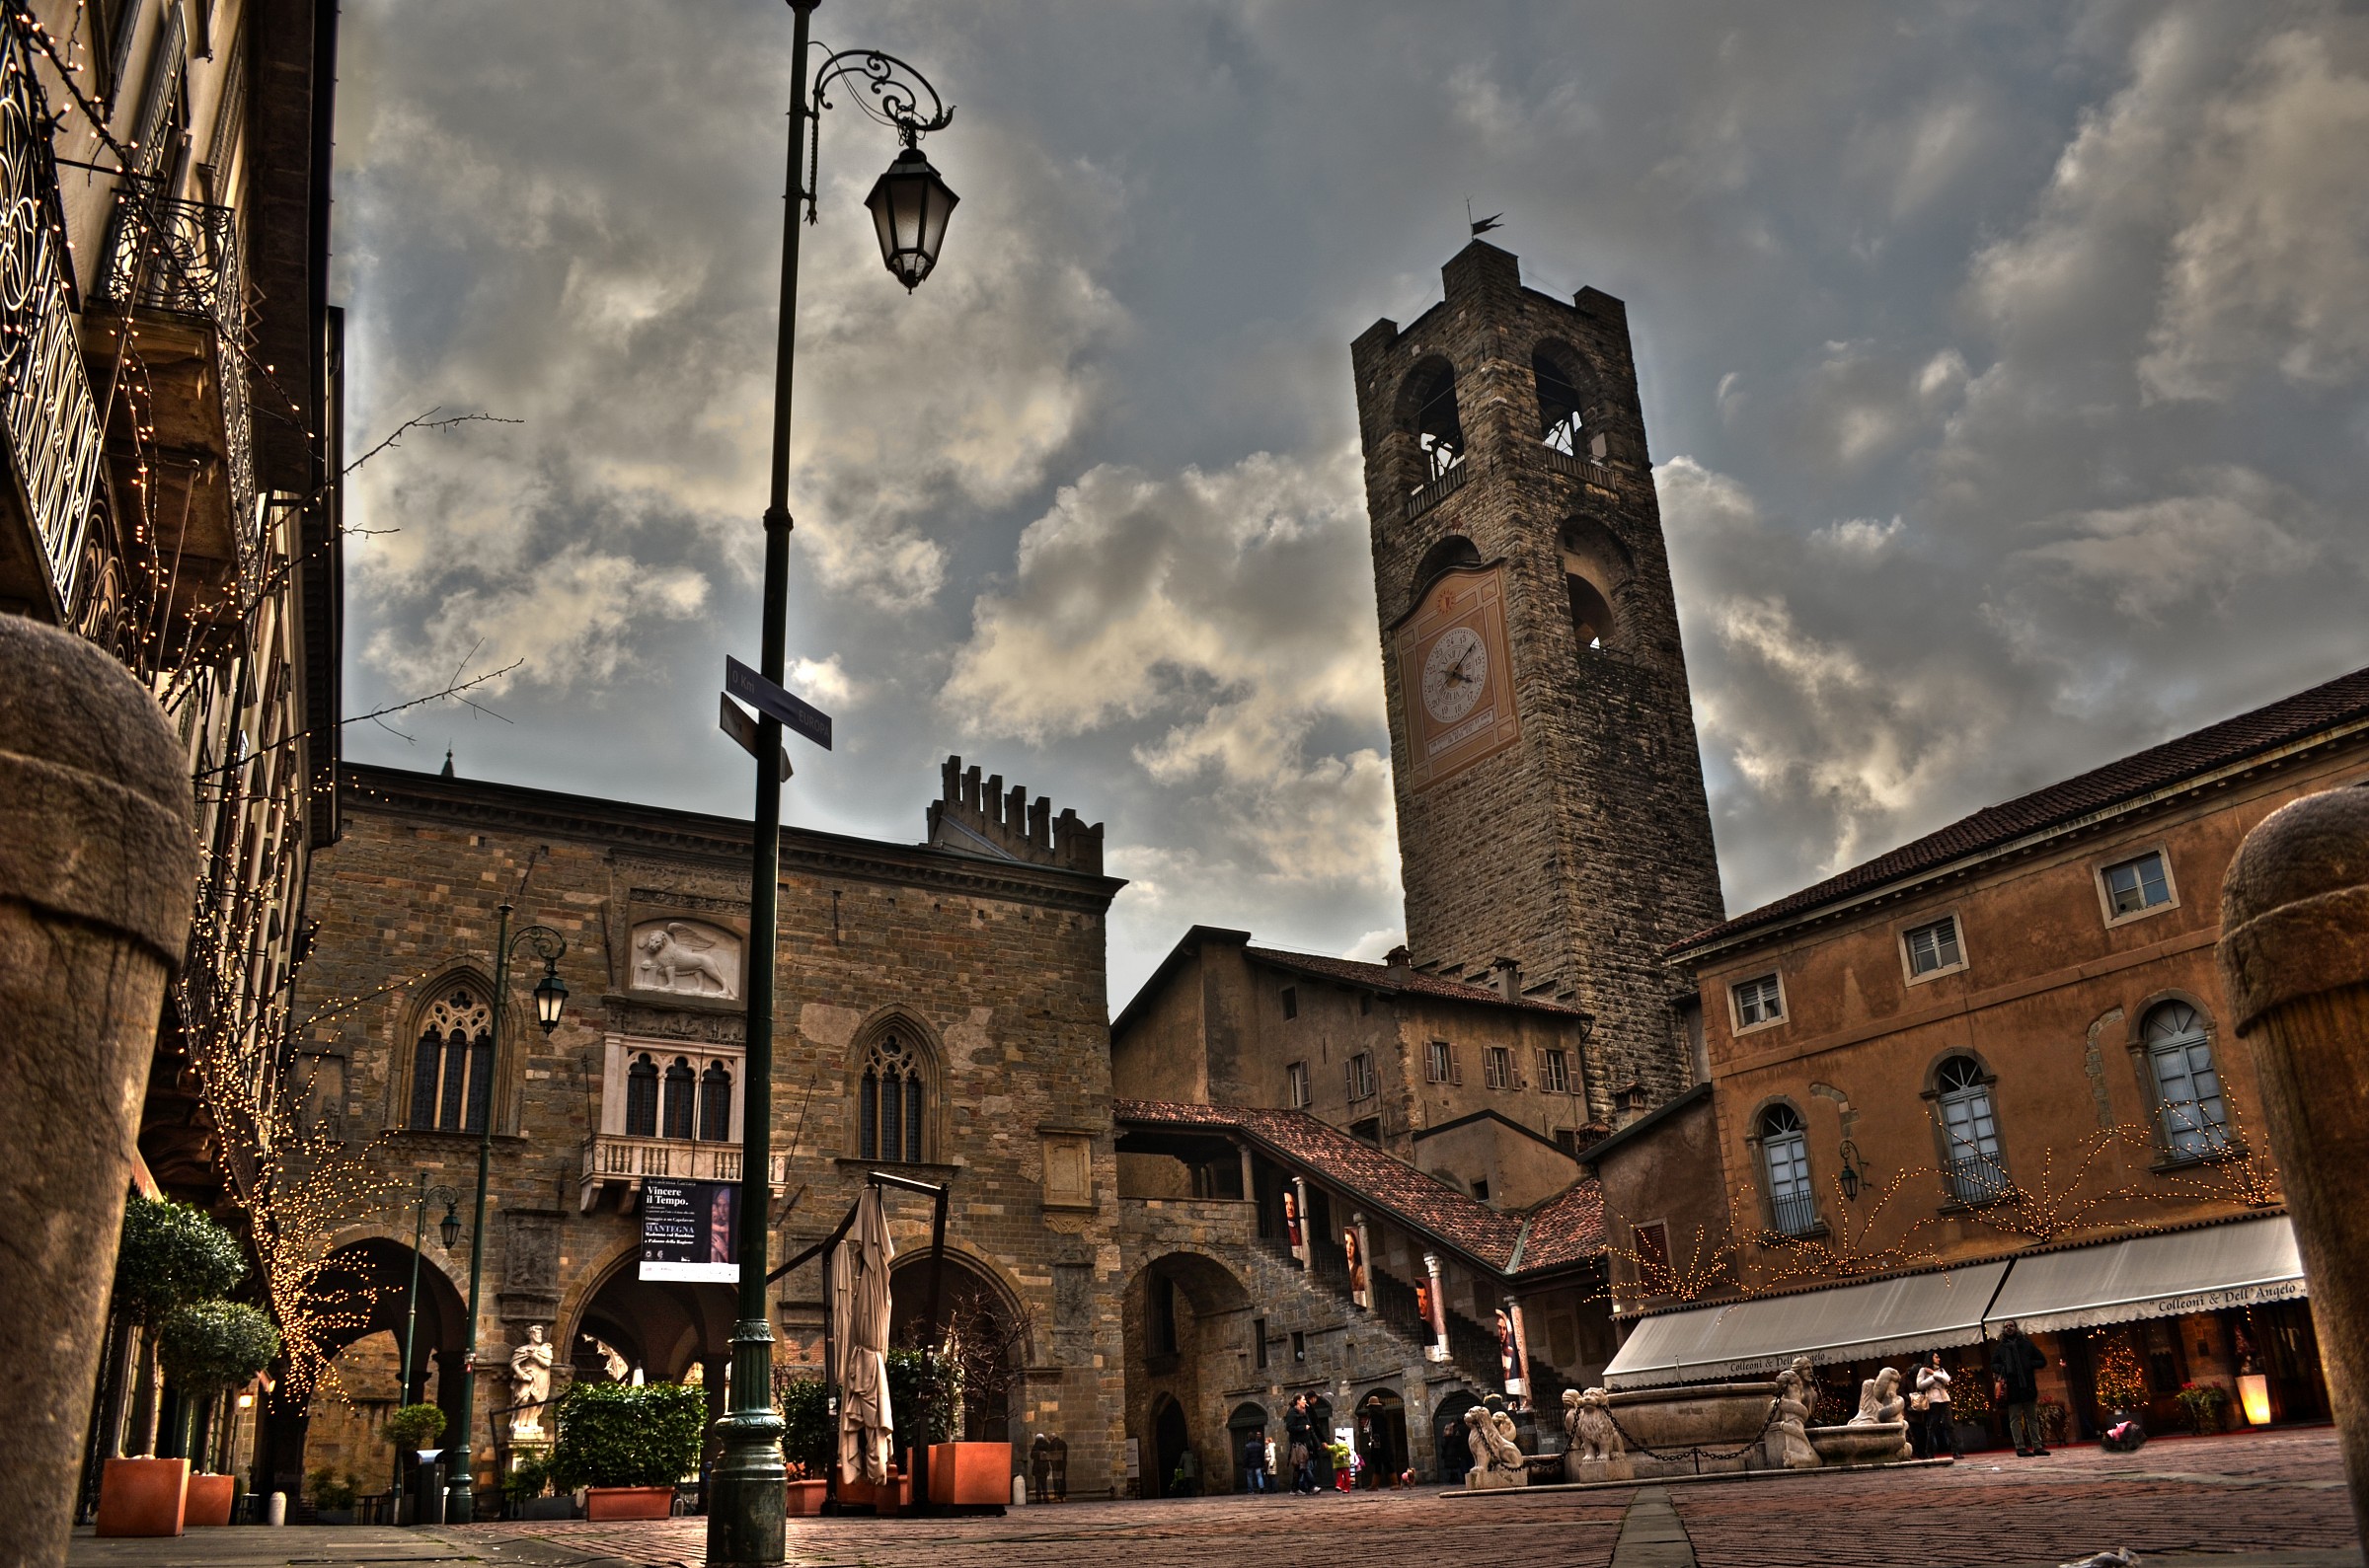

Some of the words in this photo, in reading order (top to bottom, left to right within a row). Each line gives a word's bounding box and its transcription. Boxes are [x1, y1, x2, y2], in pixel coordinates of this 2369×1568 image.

[731, 670, 738, 684] 0
[740, 674, 755, 694] Km
[799, 709, 830, 738] EUROPA
[648, 1186, 682, 1196] Vincere
[647, 1195, 652, 1204] il
[654, 1195, 689, 1207] Tempo.
[646, 1225, 695, 1233] MANTEGNA
[2158, 1295, 2204, 1311] Colleoni
[2208, 1293, 2221, 1305] &
[1730, 1360, 1762, 1373] Colleoni
[1765, 1358, 1774, 1369] &
